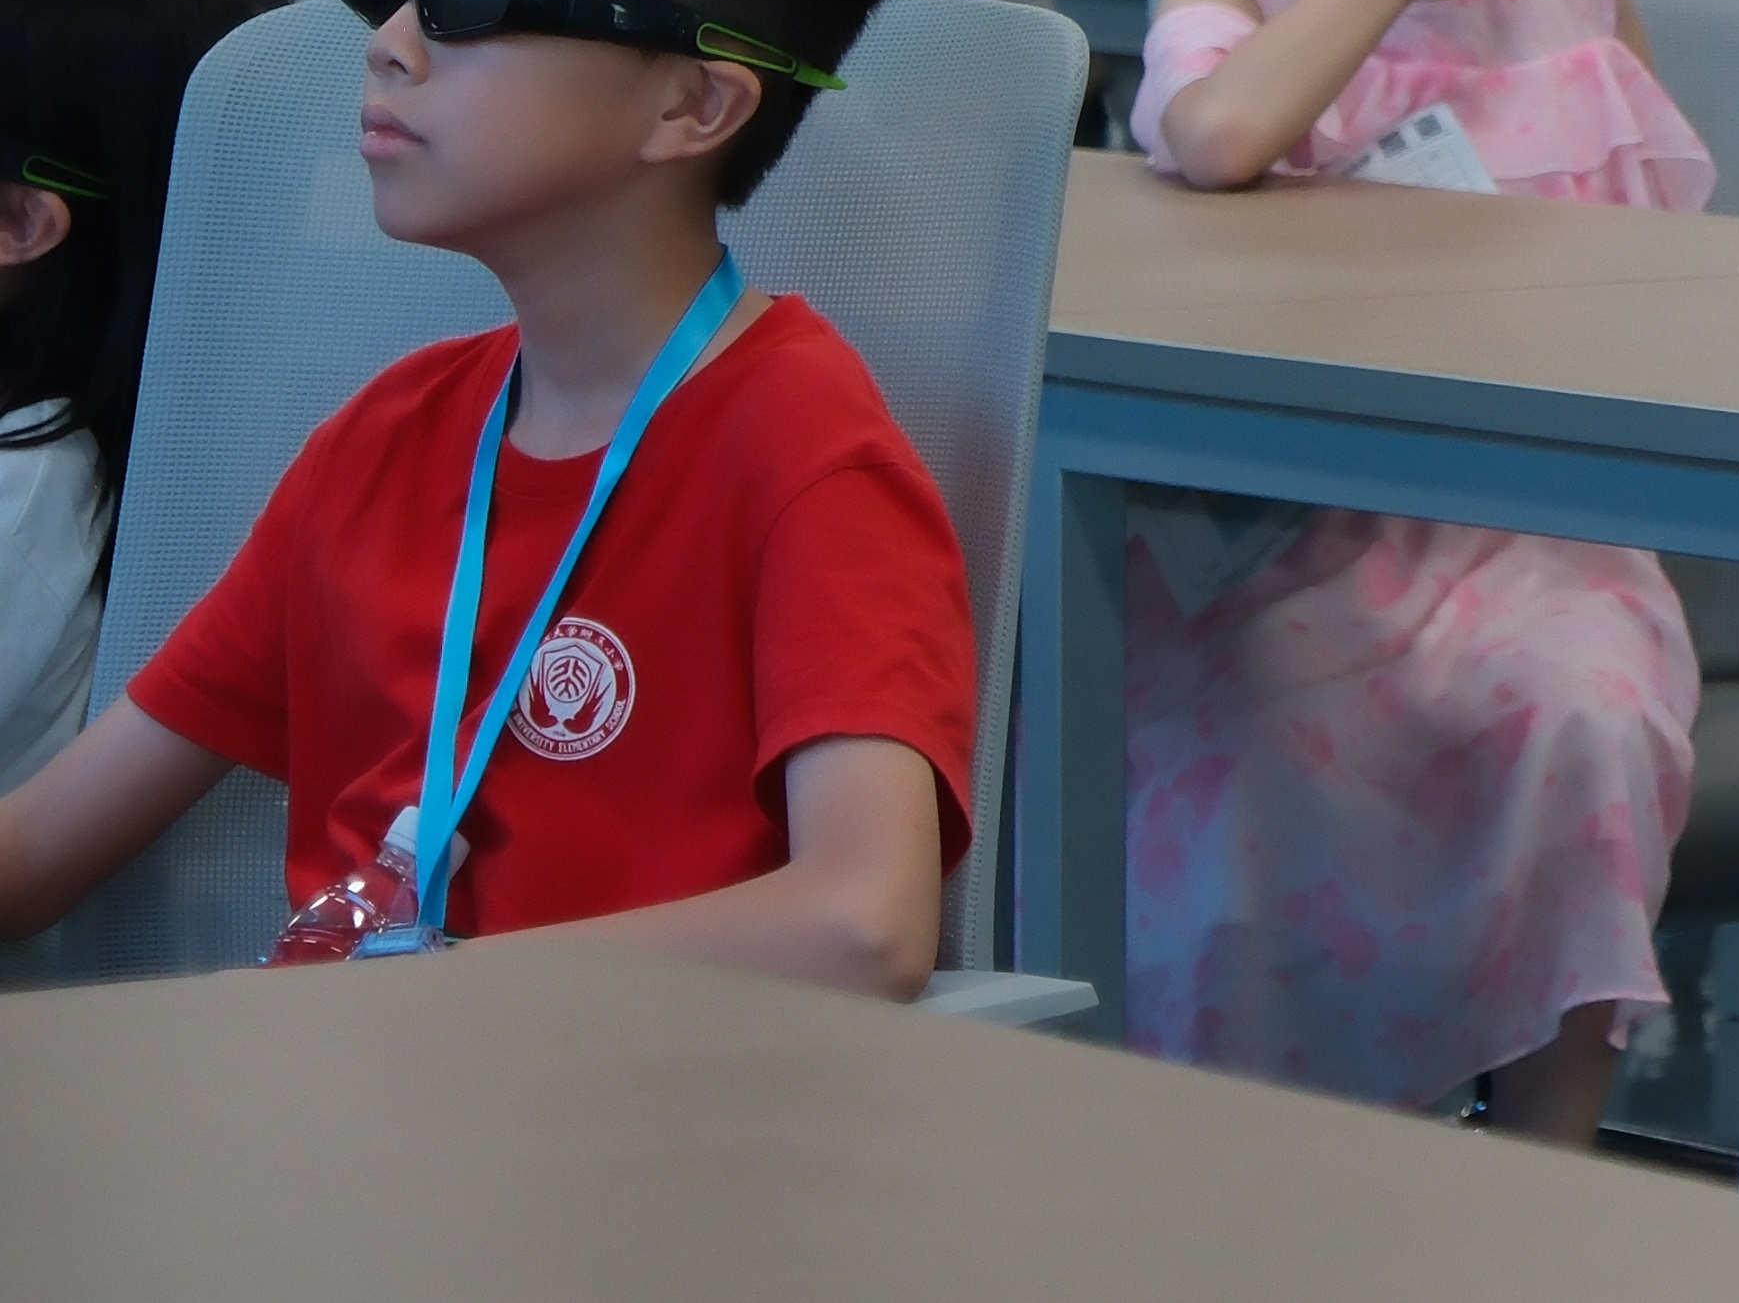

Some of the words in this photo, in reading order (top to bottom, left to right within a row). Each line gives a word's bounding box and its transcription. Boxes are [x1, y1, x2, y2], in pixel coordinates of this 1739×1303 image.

[512, 712, 556, 752] UNIVERSITY
[558, 729, 606, 754] ELEMENTARY
[604, 698, 627, 731] SCHOOL
